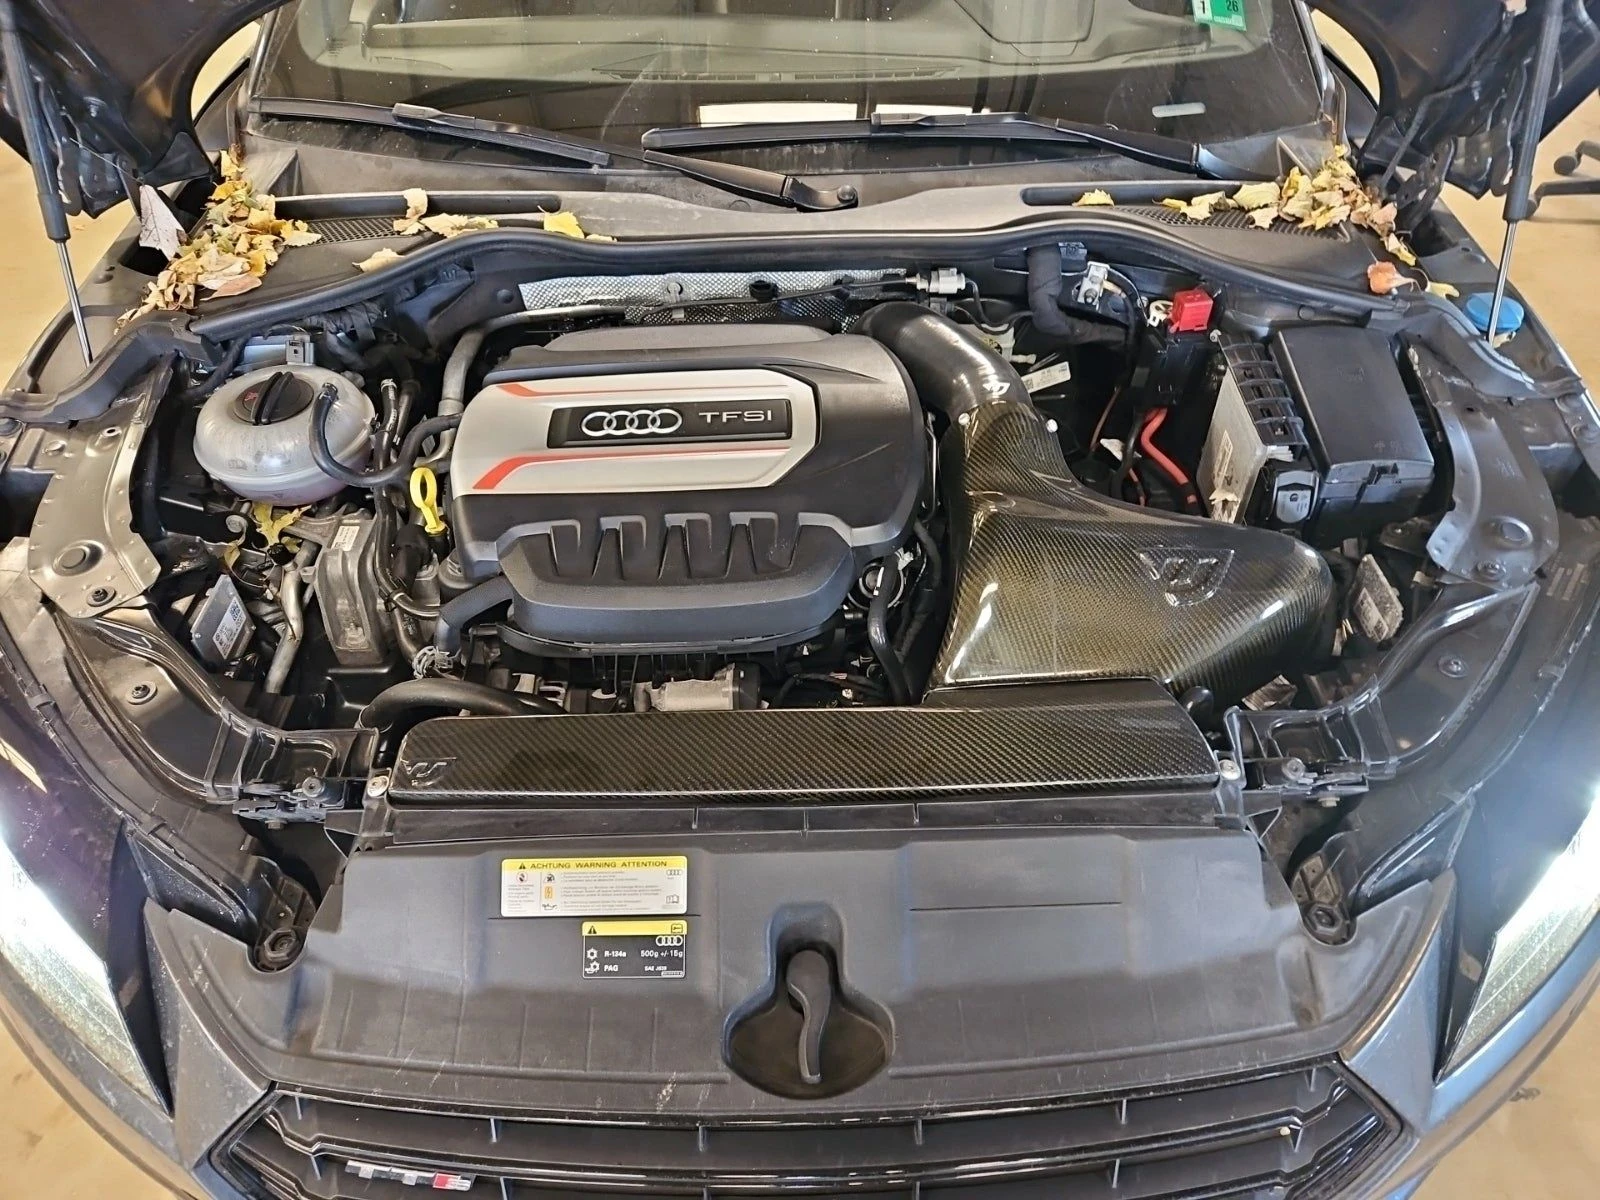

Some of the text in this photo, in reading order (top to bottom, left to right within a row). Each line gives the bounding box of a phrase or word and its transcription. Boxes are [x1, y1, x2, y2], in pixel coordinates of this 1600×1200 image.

[1226, 0, 1239, 12] 26
[698, 409, 772, 423] TFSI
[621, 860, 667, 868] ATTENTION
[640, 949, 659, 958] 500g
[604, 964, 619, 972] PAG
